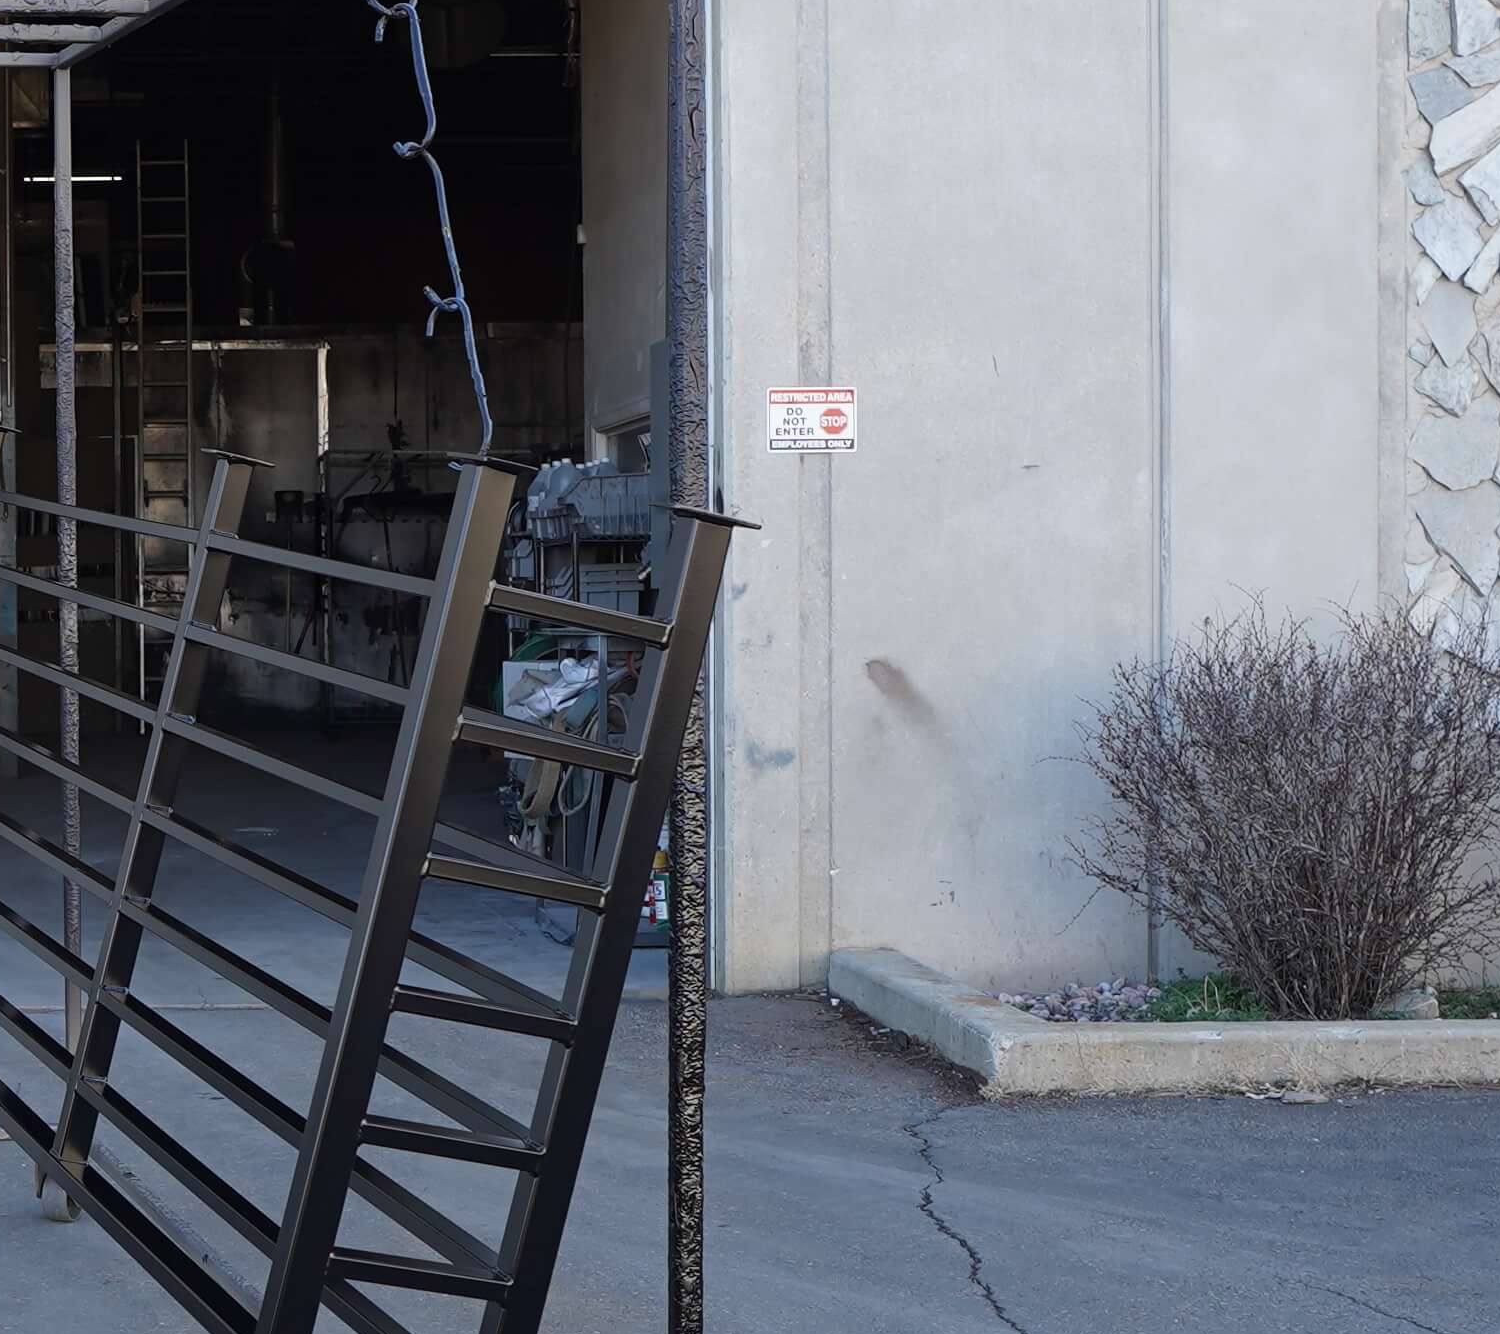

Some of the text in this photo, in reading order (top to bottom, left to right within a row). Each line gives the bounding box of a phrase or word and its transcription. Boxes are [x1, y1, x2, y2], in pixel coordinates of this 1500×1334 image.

[786, 407, 803, 416] DO
[783, 417, 807, 426] NOT
[821, 416, 847, 427] STOP
[775, 427, 815, 436] ENTER
